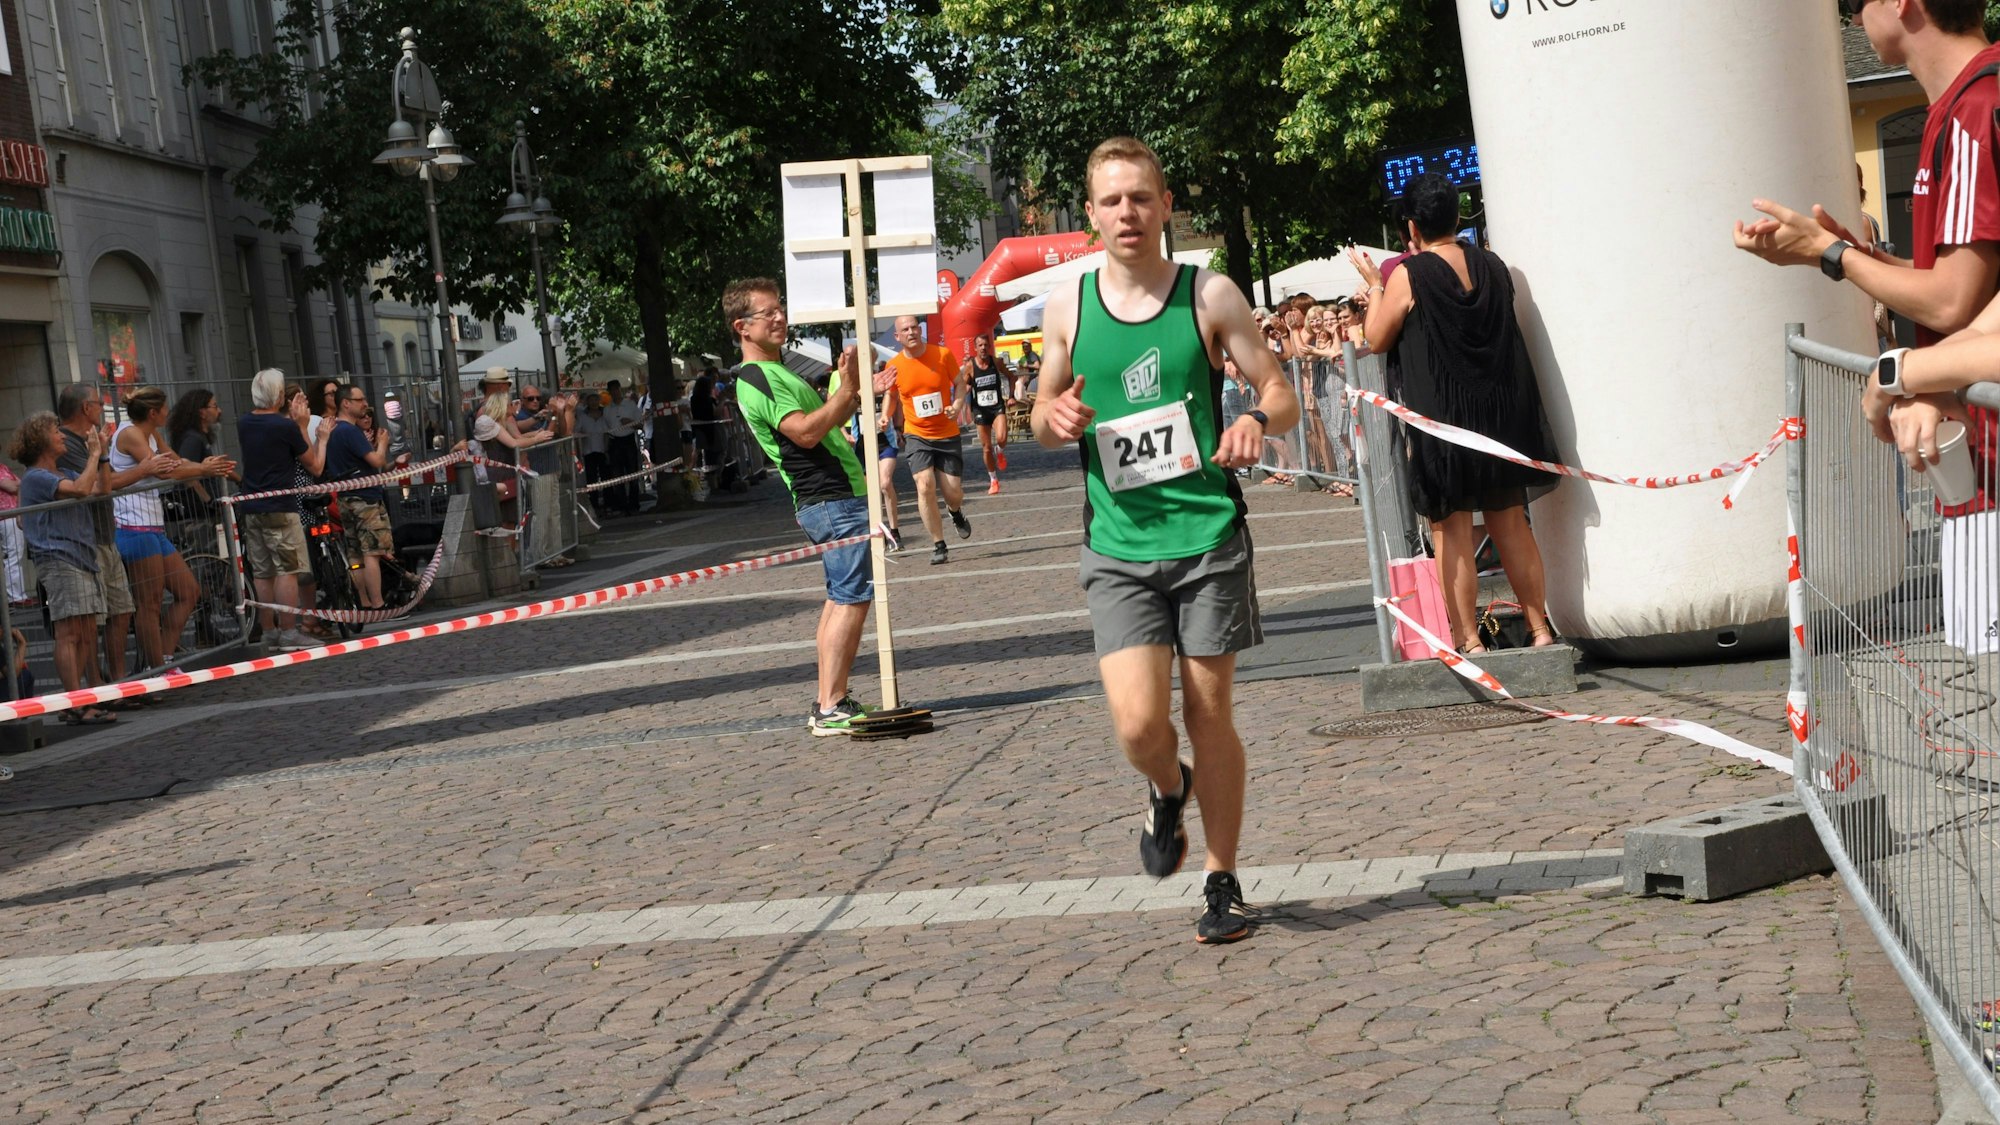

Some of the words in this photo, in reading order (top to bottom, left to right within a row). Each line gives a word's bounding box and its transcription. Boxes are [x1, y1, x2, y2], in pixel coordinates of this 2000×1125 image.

[1532, 21, 1627, 49] WWW.ROLFHORN.DE
[1125, 353, 1157, 399] BTV
[922, 399, 934, 410] 61
[981, 393, 994, 402] 243
[1114, 425, 1174, 468] 247
